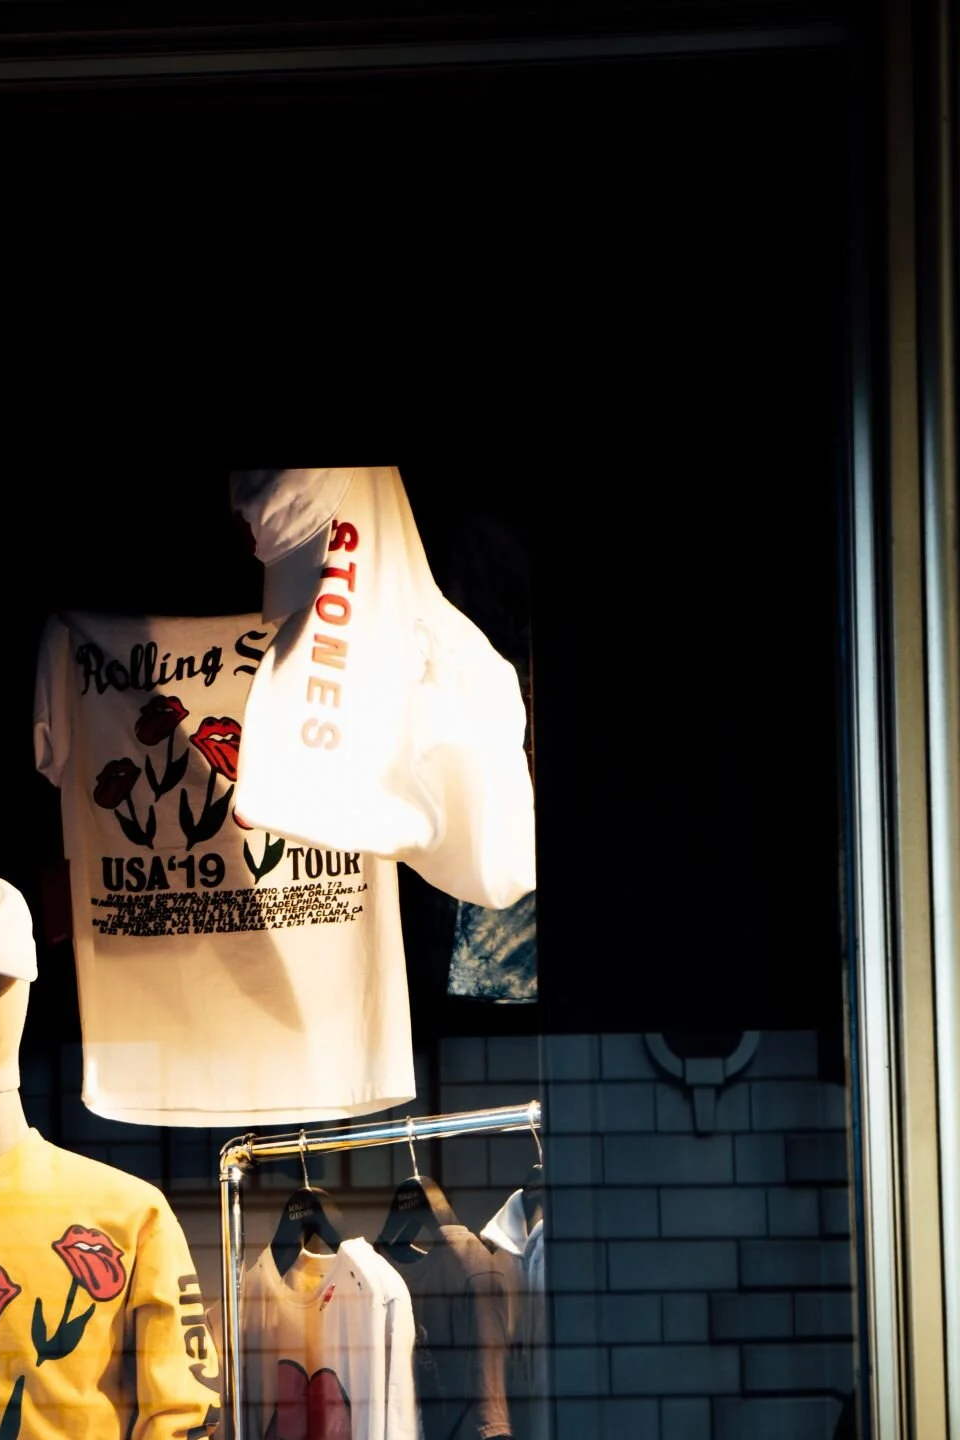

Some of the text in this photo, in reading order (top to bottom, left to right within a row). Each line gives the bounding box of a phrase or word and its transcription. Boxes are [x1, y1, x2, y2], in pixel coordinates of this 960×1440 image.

[301, 519, 359, 752] STONES
[76, 641, 224, 696] Rolling
[287, 846, 360, 880] TOUR
[282, 883, 322, 894] CANADA
[327, 881, 343, 889] 7/3
[283, 891, 306, 901] NEW
[308, 886, 356, 898] ORLEANS,
[357, 882, 368, 892] LA
[282, 911, 313, 922] SANTA
[352, 905, 363, 914] CA
[311, 916, 342, 925] MIAMI,
[345, 913, 356, 921] FL
